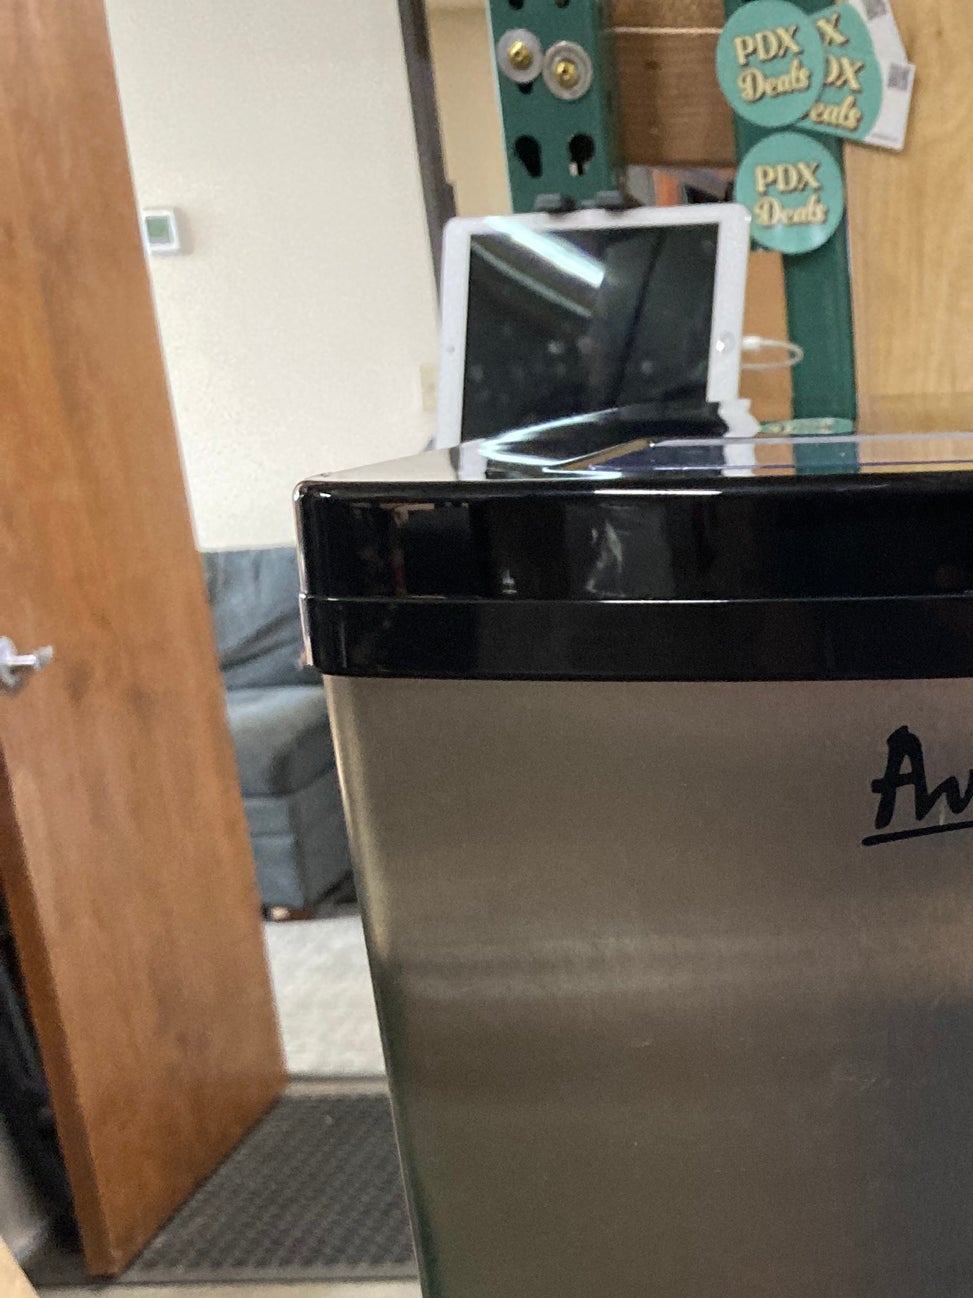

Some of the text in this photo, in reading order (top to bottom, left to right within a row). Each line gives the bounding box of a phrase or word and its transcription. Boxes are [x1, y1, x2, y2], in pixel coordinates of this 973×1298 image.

[733, 24, 804, 66] PDX
[737, 57, 811, 103] Deals
[754, 161, 823, 195] PDX
[753, 194, 829, 228] Deals
